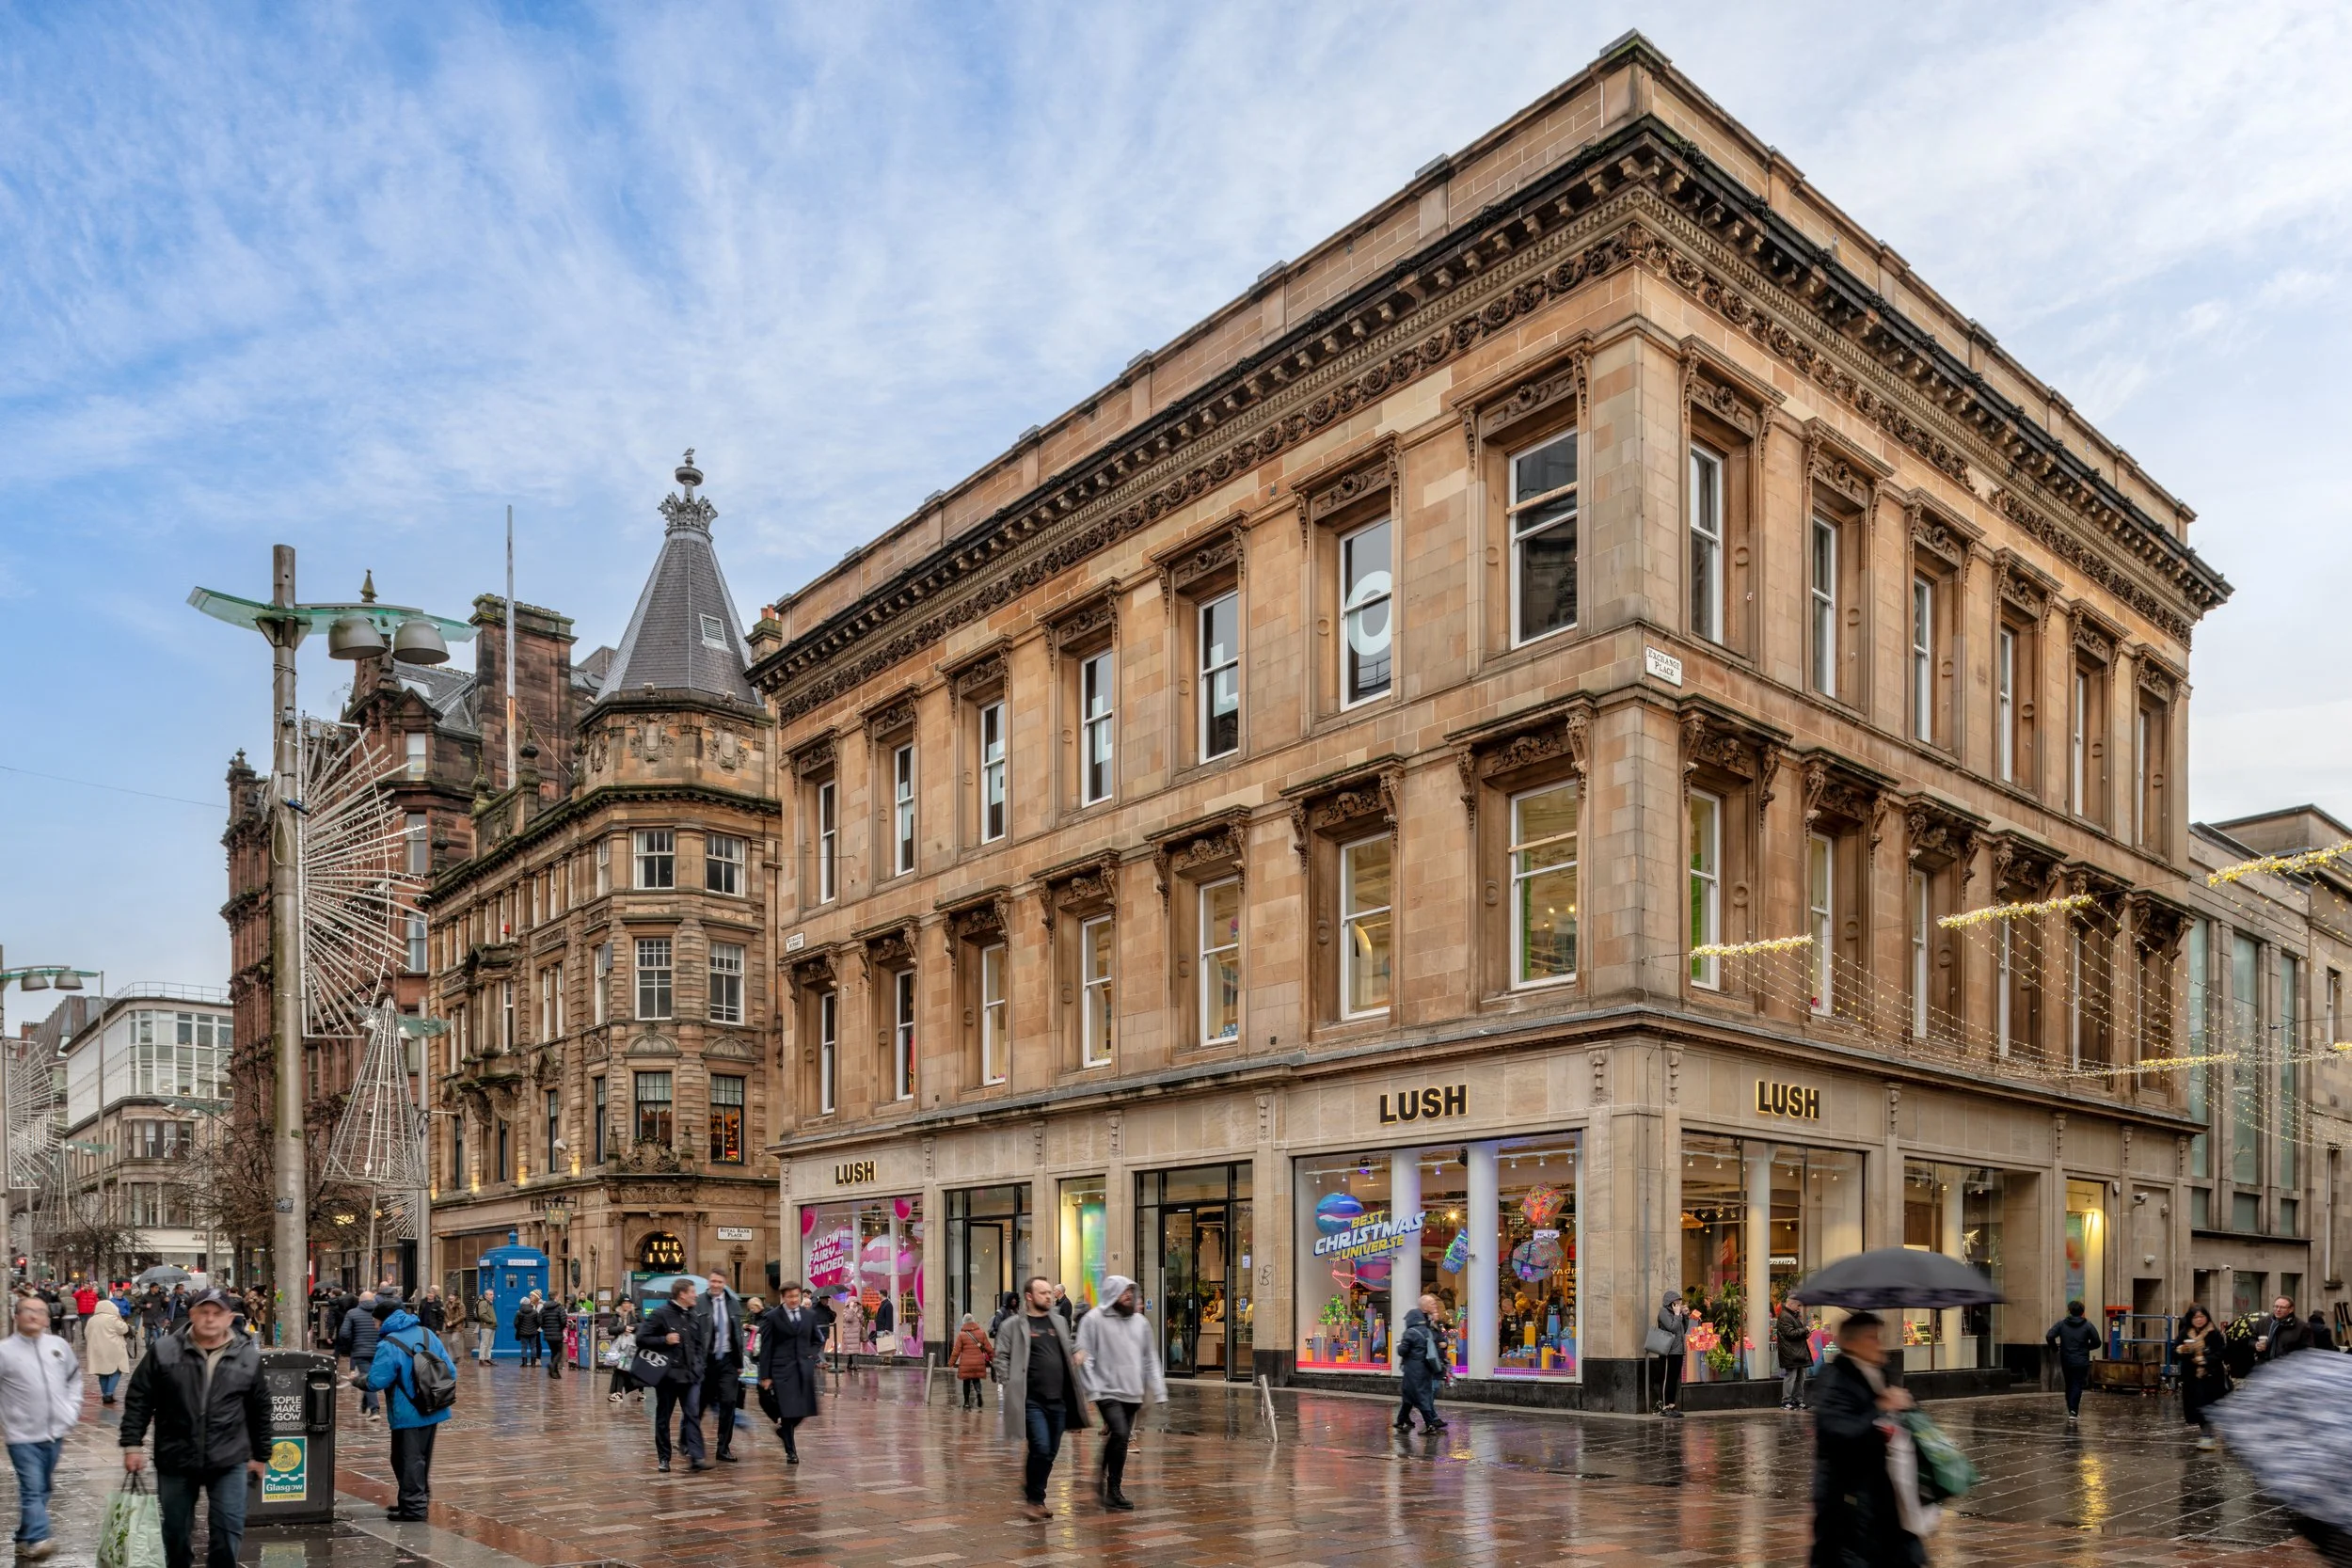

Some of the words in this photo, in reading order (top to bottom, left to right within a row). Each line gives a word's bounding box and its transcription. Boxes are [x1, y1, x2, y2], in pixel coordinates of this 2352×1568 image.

[1647, 648, 1680, 670] EXCHANGE
[1655, 661, 1674, 676] PLACE
[1379, 1084, 1469, 1124] LUSH
[1756, 1080, 1820, 1120] LUSH
[834, 1160, 876, 1185] LUSH
[1350, 1210, 1385, 1228] BEST
[813, 1230, 840, 1252] SNOW
[1313, 1212, 1426, 1257] CHRISTMAS
[647, 1252, 682, 1263] IVY
[652, 1242, 679, 1251] THE
[809, 1243, 835, 1265] FAIRY
[1340, 1234, 1405, 1261] UNIVERSE
[808, 1256, 844, 1278] LANDED
[271, 1396, 302, 1404] EOPLE
[273, 1404, 302, 1413] MAKE
[270, 1413, 301, 1421] SGOW
[265, 1483, 303, 1493] Glasgow
